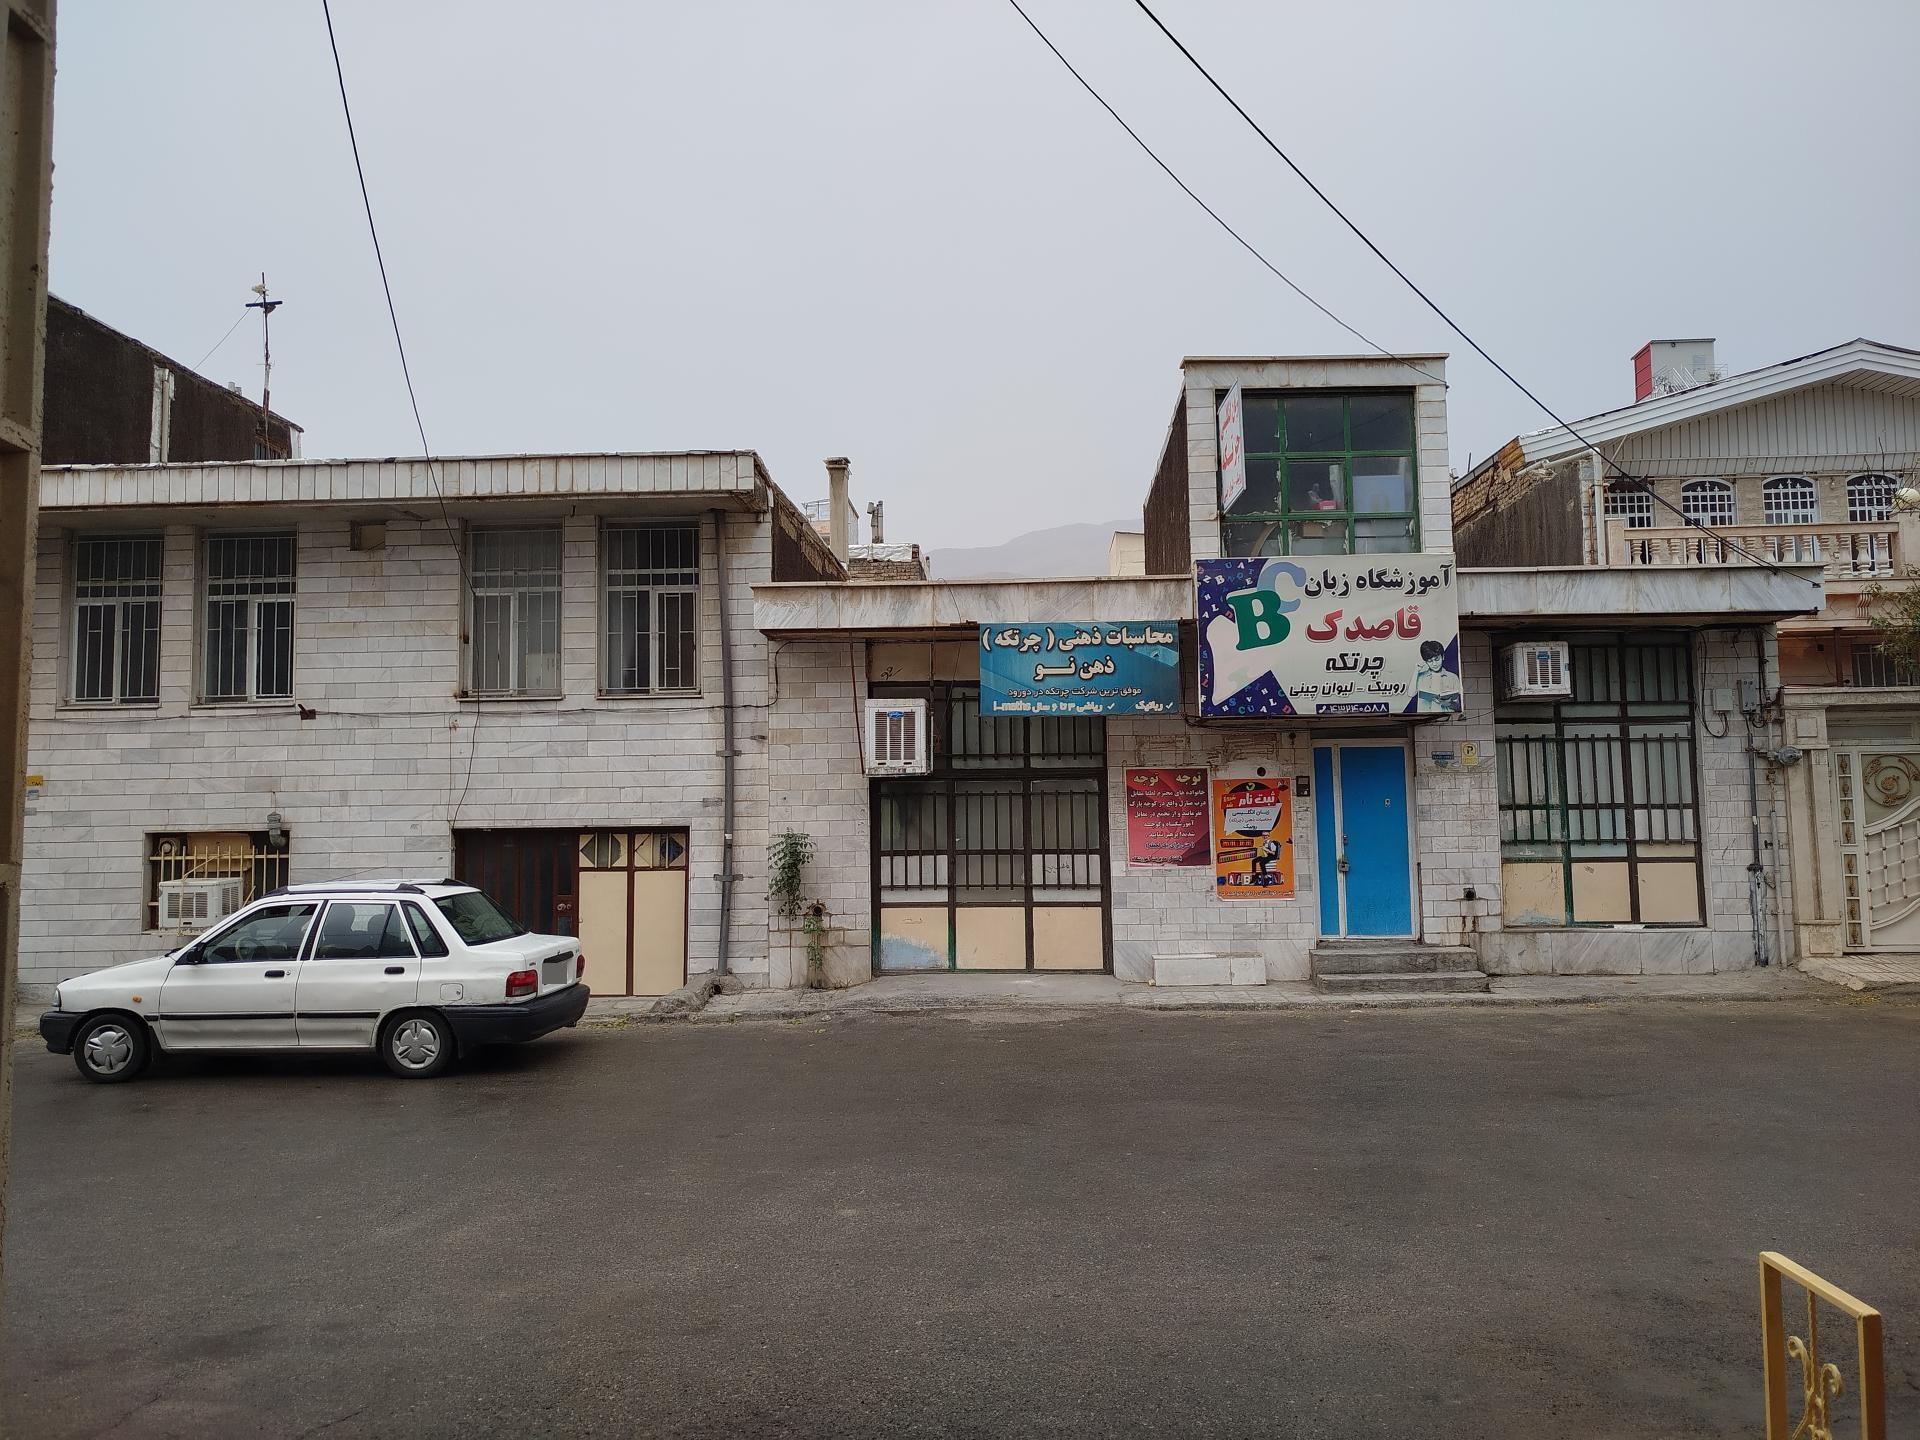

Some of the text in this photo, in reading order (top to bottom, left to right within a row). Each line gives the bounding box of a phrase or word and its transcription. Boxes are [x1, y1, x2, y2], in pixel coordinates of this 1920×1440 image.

[1304, 564, 1453, 597] آموزشگاه زبان
[1306, 604, 1422, 641] قاصدک
[1059, 625, 1102, 651] ذهنی
[1105, 625, 1174, 649] محاسبات
[1079, 655, 1115, 680] ذهن
[1325, 653, 1384, 679] چرتکه
[1008, 686, 1142, 698] موفق ترین شرکت چرتکه در دورود
[1289, 683, 1318, 701] چینی
[1321, 681, 1353, 697] لیوان
[1367, 680, 1406, 696] روبیک
[1076, 701, 1103, 712] ریاضی
[1133, 772, 1202, 786] توجه توجه
[1239, 791, 1275, 807] ثبت نام
